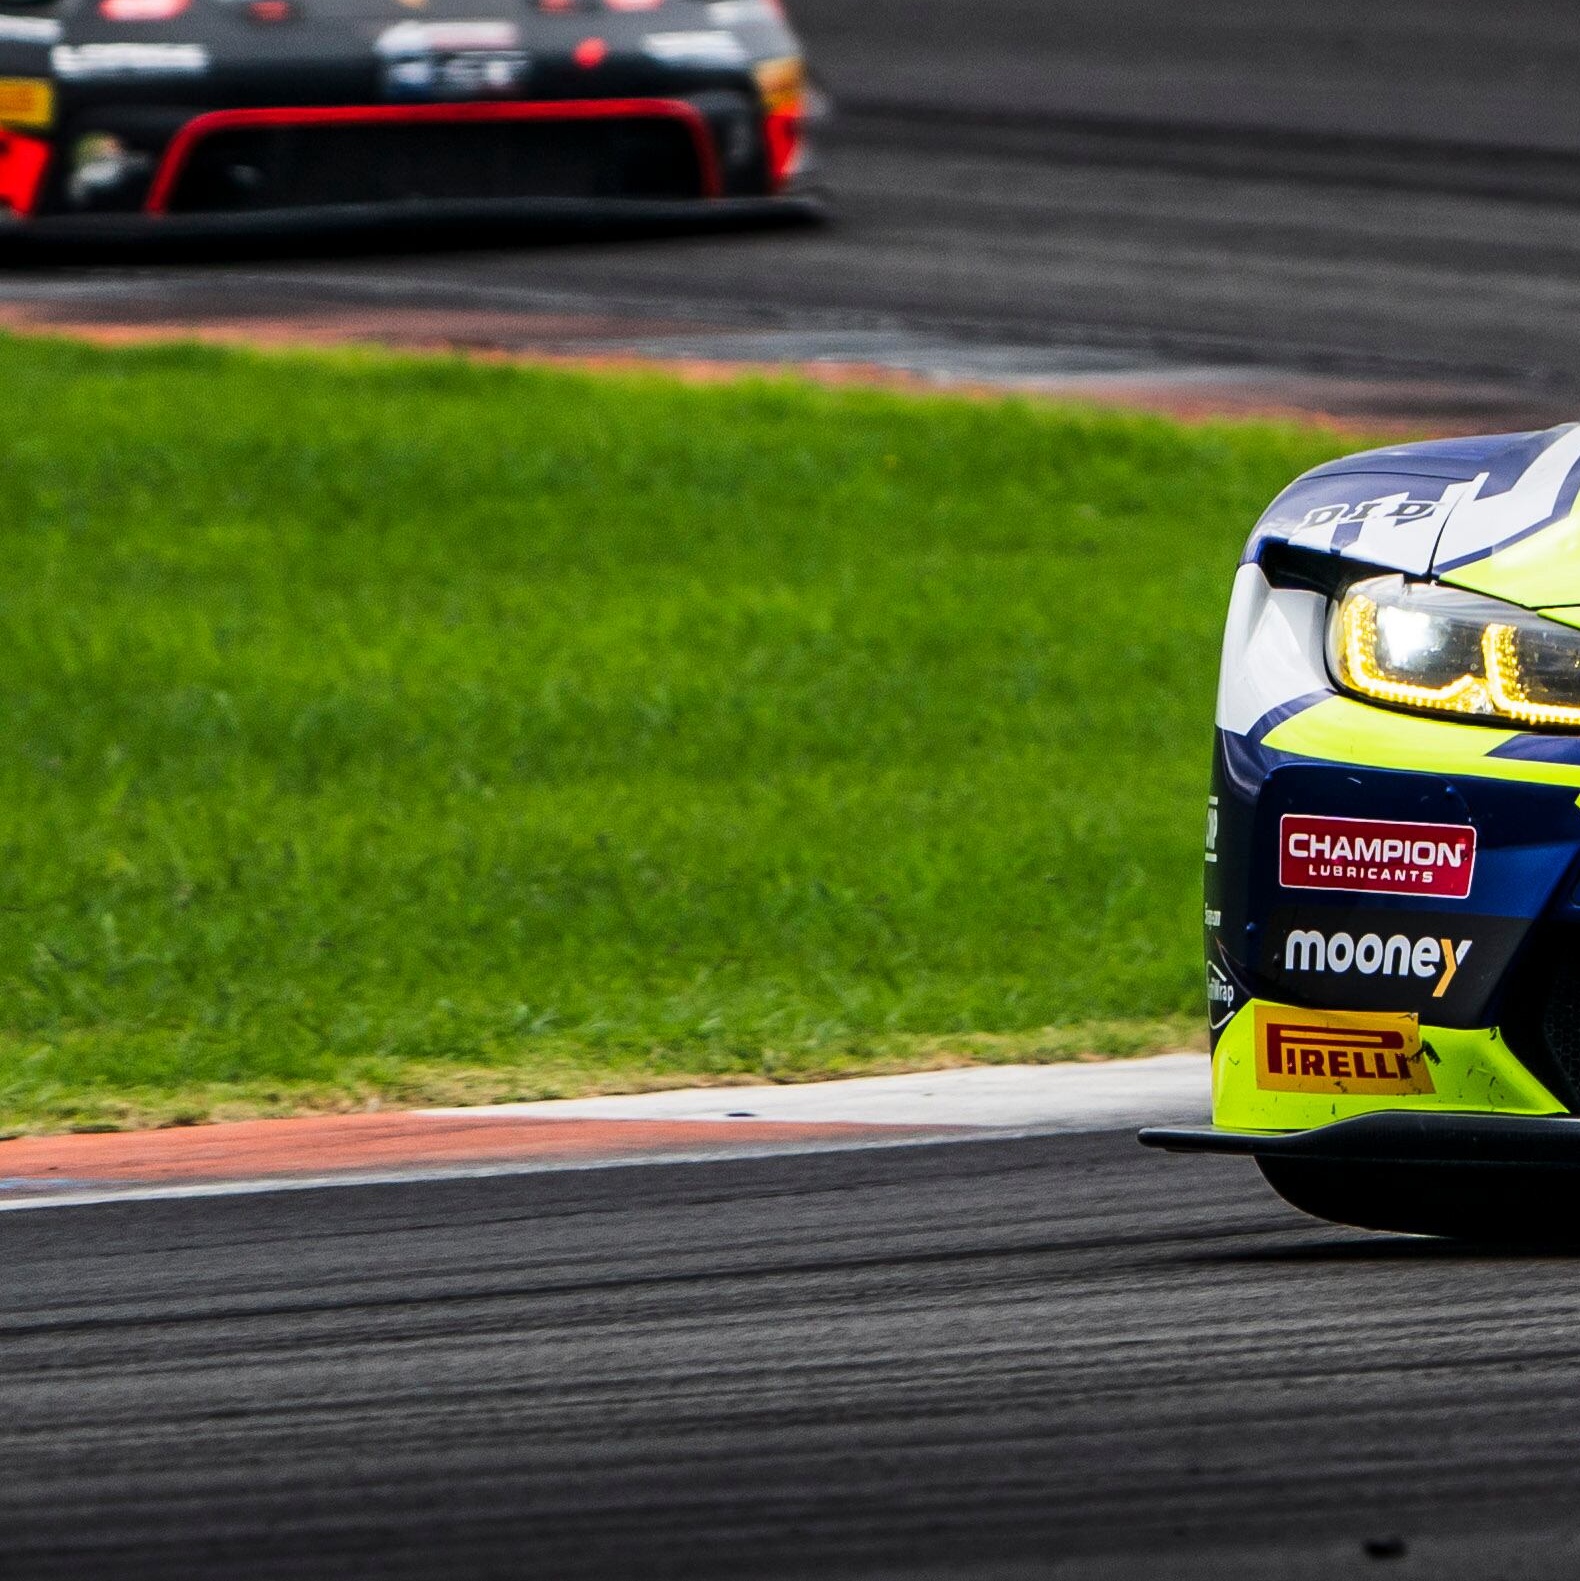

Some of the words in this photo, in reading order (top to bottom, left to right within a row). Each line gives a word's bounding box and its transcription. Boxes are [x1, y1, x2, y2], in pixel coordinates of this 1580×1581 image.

[1288, 833, 1462, 868] CHAMPION
[1308, 864, 1434, 884] LUBRICANTS
[1285, 929, 1473, 998] mooney
[1266, 1023, 1413, 1080] PIRELLI
